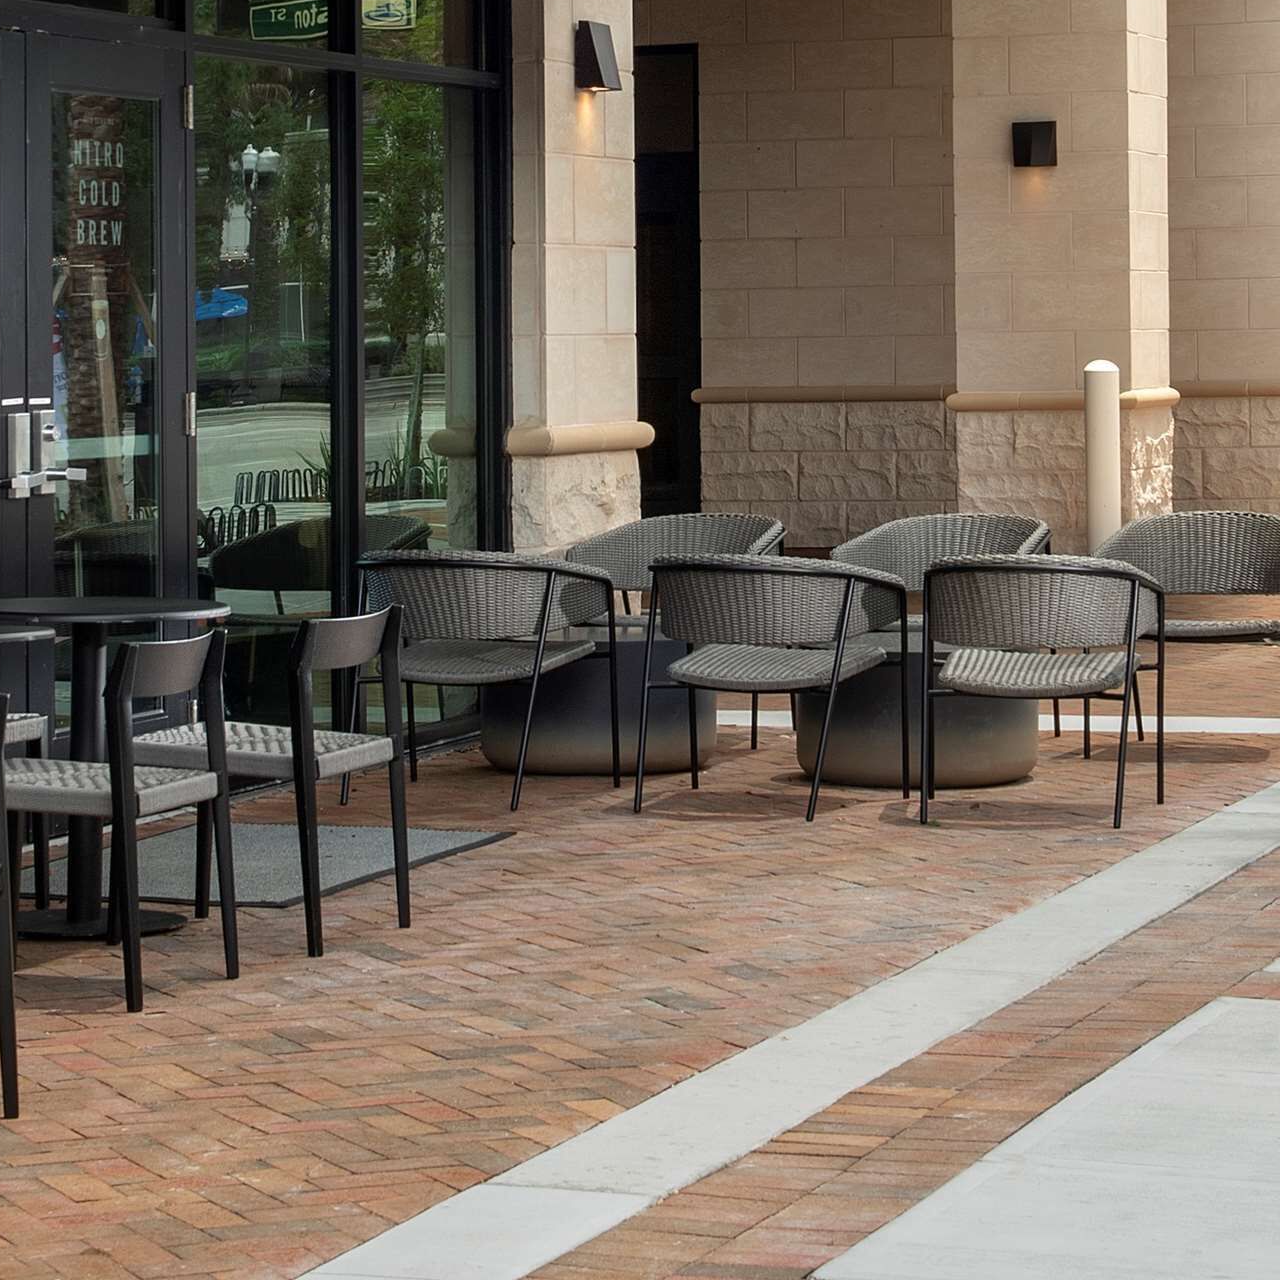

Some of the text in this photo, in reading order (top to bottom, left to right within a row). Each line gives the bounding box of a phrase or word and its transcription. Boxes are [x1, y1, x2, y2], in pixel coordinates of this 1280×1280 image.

[74, 139, 124, 168] NITRO
[79, 179, 120, 207] COLD
[76, 219, 122, 246] BREW
